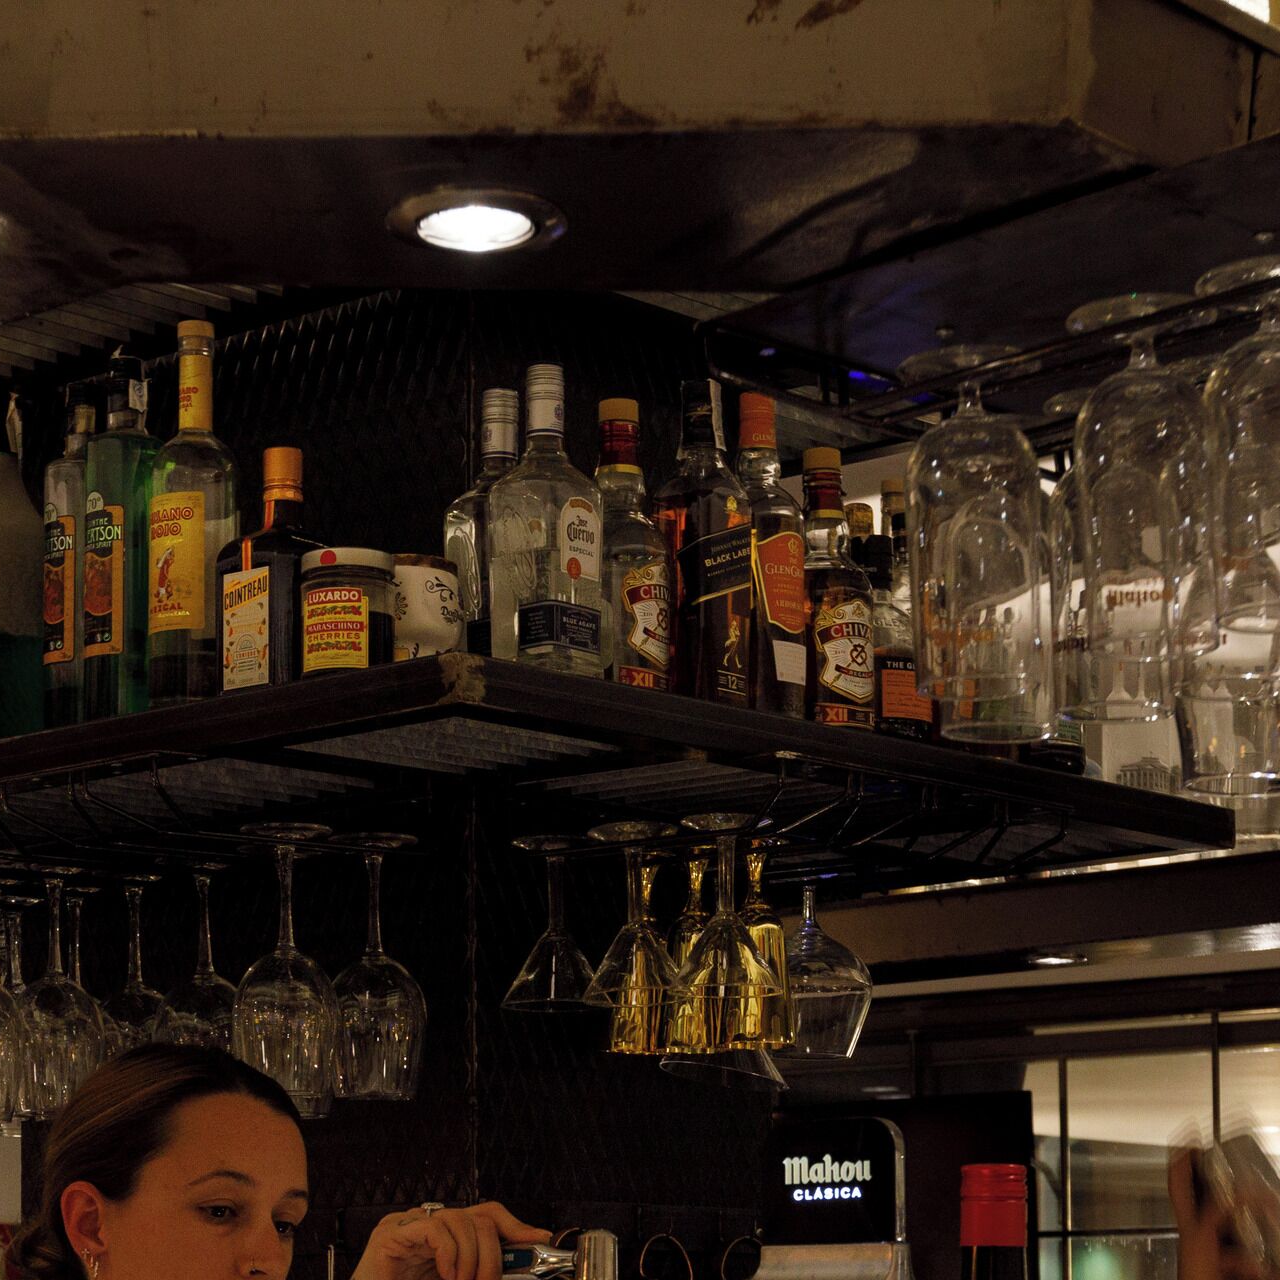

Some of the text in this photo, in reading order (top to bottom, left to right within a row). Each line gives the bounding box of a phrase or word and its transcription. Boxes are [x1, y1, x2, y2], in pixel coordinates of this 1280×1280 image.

[566, 521, 595, 545] Cuervo
[569, 545, 595, 557] ESPECIAL
[704, 552, 731, 568] BLACK
[223, 574, 269, 612] COINTREAU
[308, 590, 360, 603] LUXARDO
[306, 622, 361, 633] MARASCHINO
[562, 616, 596, 630] BLUE AGAVE
[307, 632, 361, 642] CHERRIES
[886, 661, 905, 669] THE
[632, 671, 654, 688] XII
[727, 675, 738, 689] 12
[824, 706, 848, 723] XII
[782, 1154, 872, 1185] Mahou
